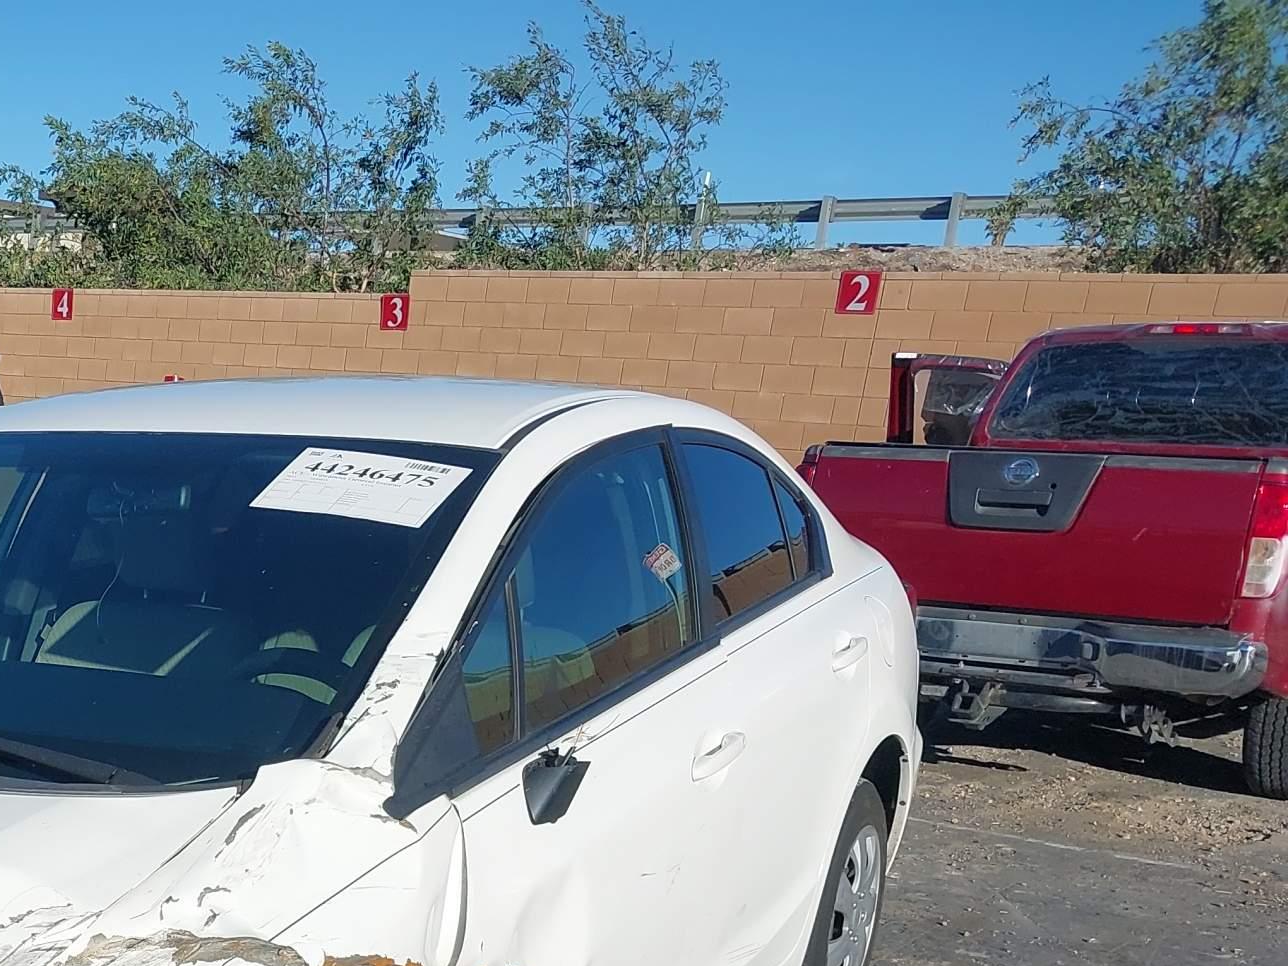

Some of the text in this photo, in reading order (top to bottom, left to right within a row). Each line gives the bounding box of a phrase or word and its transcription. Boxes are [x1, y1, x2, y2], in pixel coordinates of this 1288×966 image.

[57, 291, 69, 318] 4
[845, 274, 870, 311] 2
[387, 297, 403, 327] 3
[305, 461, 440, 488] 44246475
